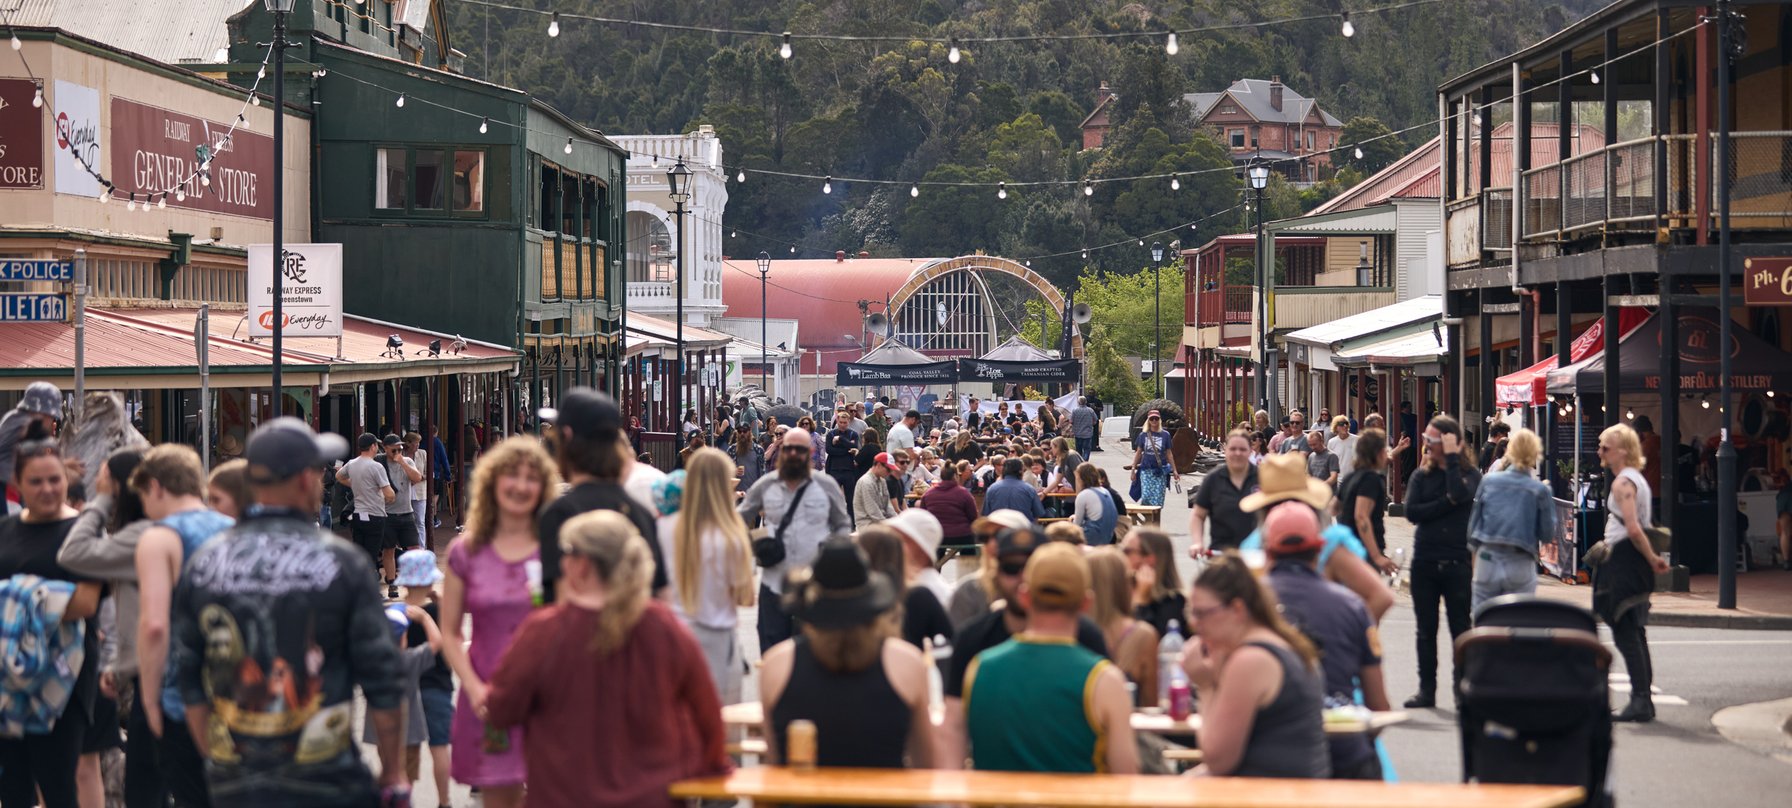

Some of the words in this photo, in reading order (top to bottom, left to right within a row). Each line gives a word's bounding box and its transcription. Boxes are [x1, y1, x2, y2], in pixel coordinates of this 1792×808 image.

[135, 150, 203, 199] GENERAL
[220, 167, 257, 207] STORE
[11, 262, 71, 279] POLICE
[1754, 269, 1779, 289] Ph.
[294, 287, 322, 295] EXPRESS
[289, 313, 333, 329] Everyday
